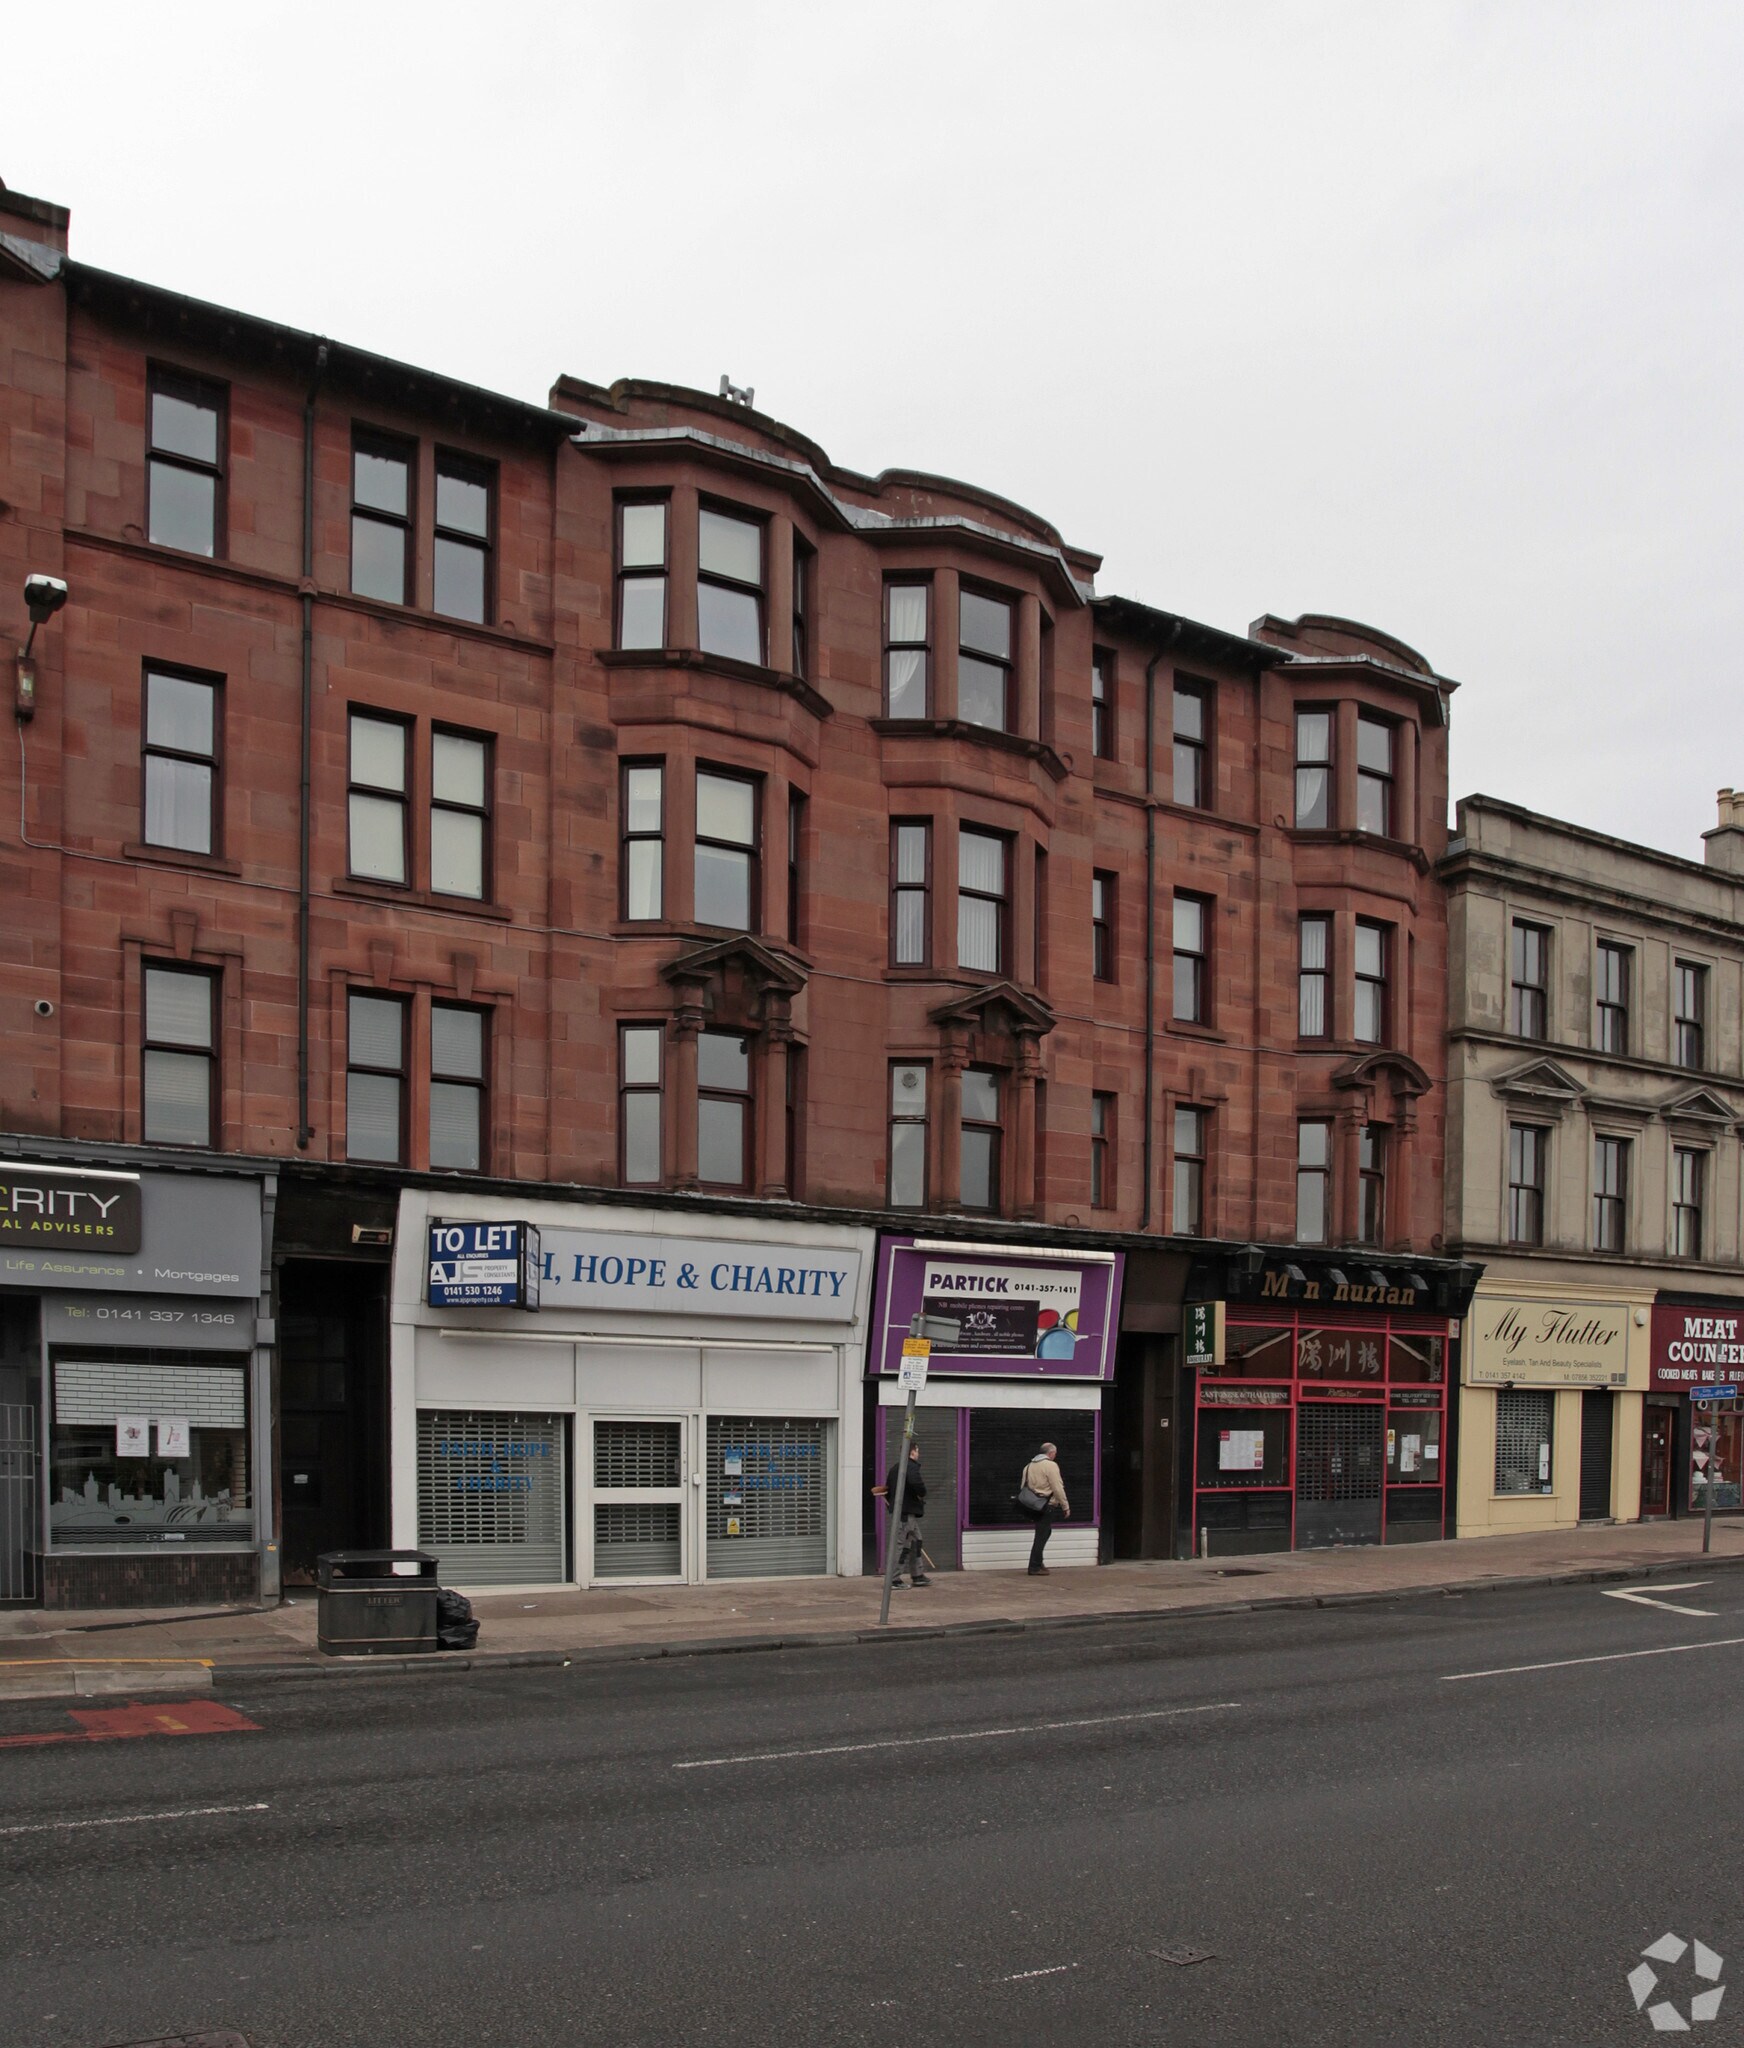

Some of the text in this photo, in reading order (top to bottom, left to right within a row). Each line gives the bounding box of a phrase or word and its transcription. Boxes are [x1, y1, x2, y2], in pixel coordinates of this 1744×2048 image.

[30, 1222, 114, 1235] ADVISERS
[432, 1226, 517, 1252] TO LET
[6, 1260, 239, 1282] Life Assurance Mortgages
[572, 1254, 667, 1287] HOPE
[676, 1263, 700, 1289] &
[710, 1263, 847, 1297] CHARITY
[444, 1286, 502, 1296] 0141 530 1246
[929, 1273, 1077, 1294] PARTICK 0141-357-1411
[64, 1306, 235, 1324] Tel: 0141 337 1346
[1484, 1307, 1618, 1354] My Flutter
[1683, 1317, 1738, 1339] MEAT
[1552, 1360, 1572, 1368] Beauty
[1573, 1360, 1602, 1369] Specialists
[1658, 1368, 1681, 1379] COOKED
[1681, 1369, 1699, 1380] MEATS
